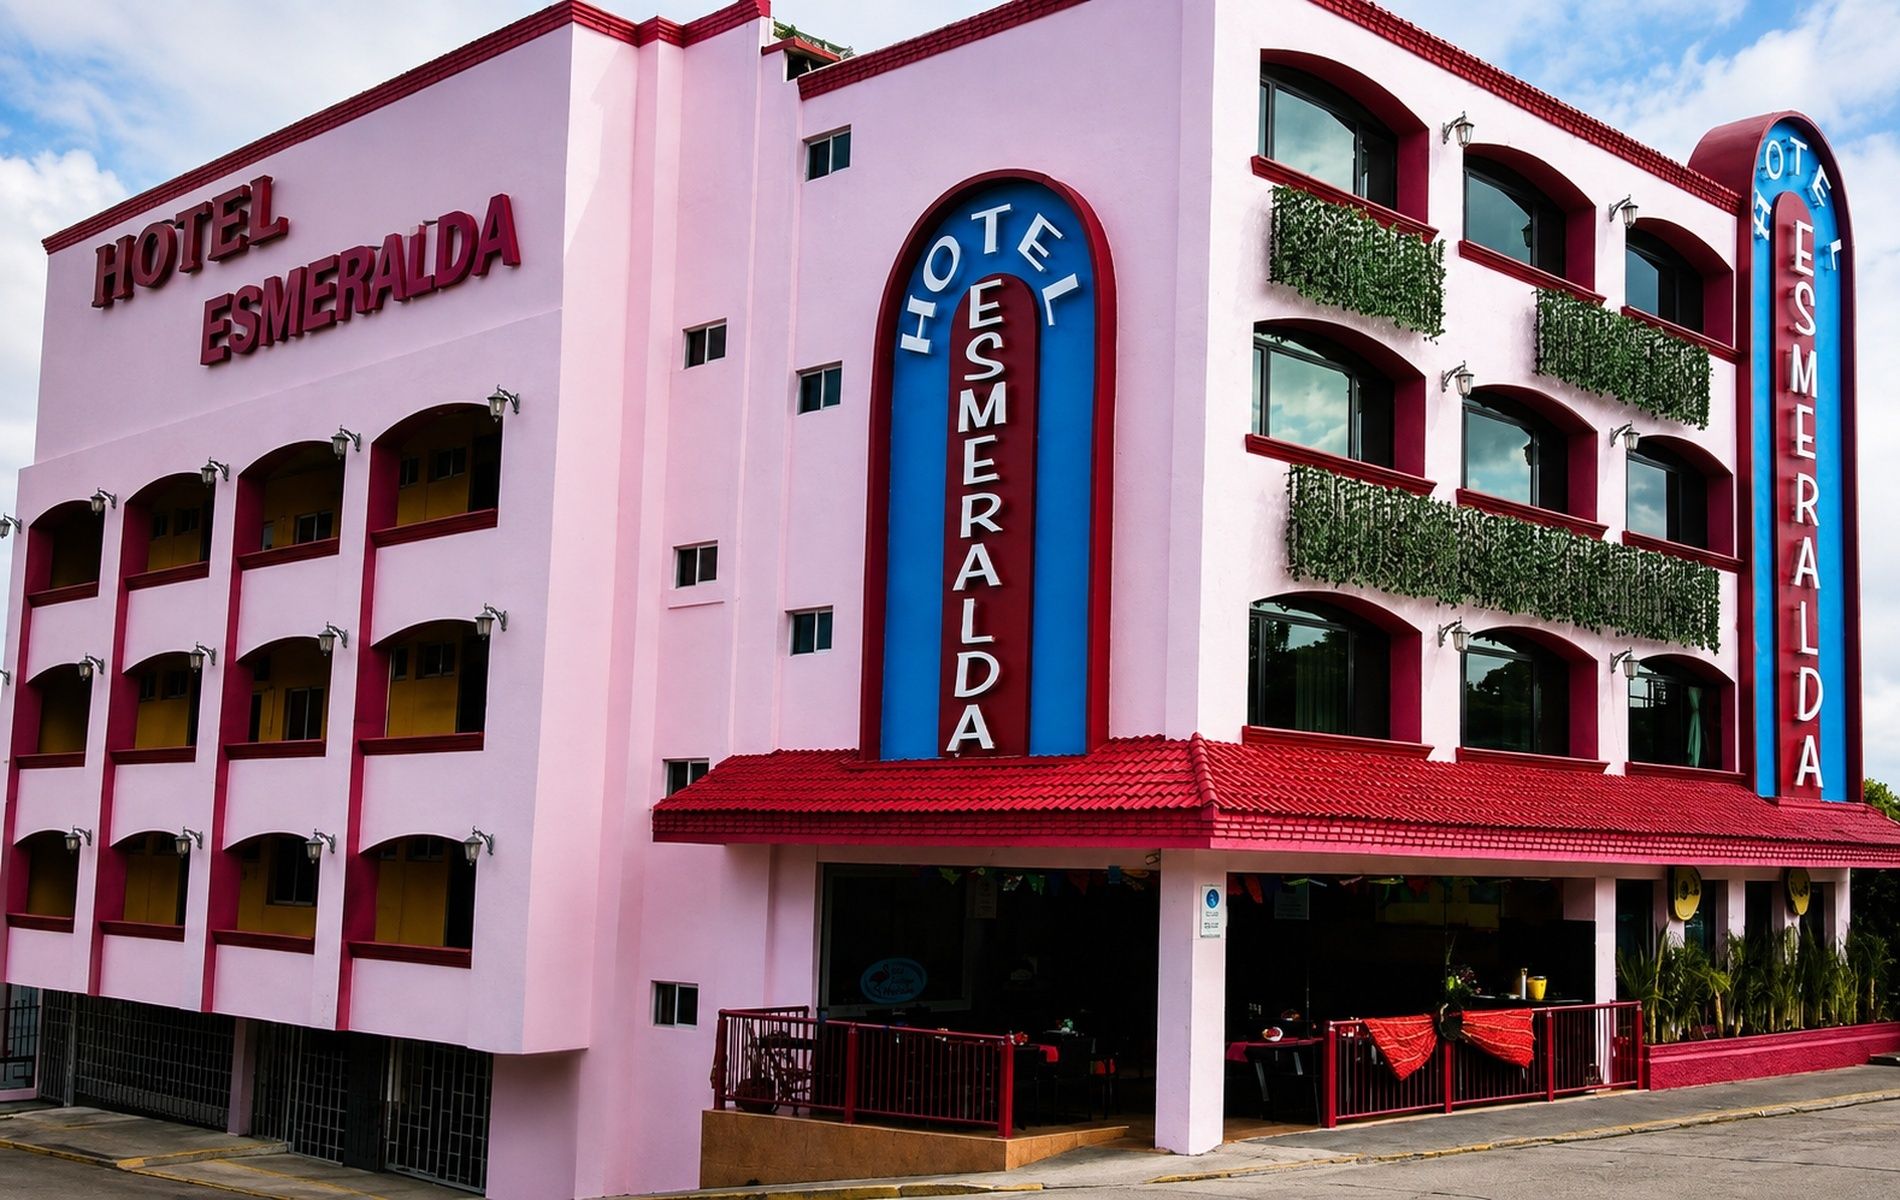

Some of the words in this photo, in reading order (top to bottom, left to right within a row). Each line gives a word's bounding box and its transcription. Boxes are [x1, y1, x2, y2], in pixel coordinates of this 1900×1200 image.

[93, 176, 288, 307] HOTEL
[201, 194, 519, 365] ESMERALDA
[900, 203, 1079, 354] HOTEL
[1753, 136, 1842, 269] HOTEL
[946, 278, 1007, 752] ESMERALDA
[1790, 219, 1824, 788] ESMERALDA
